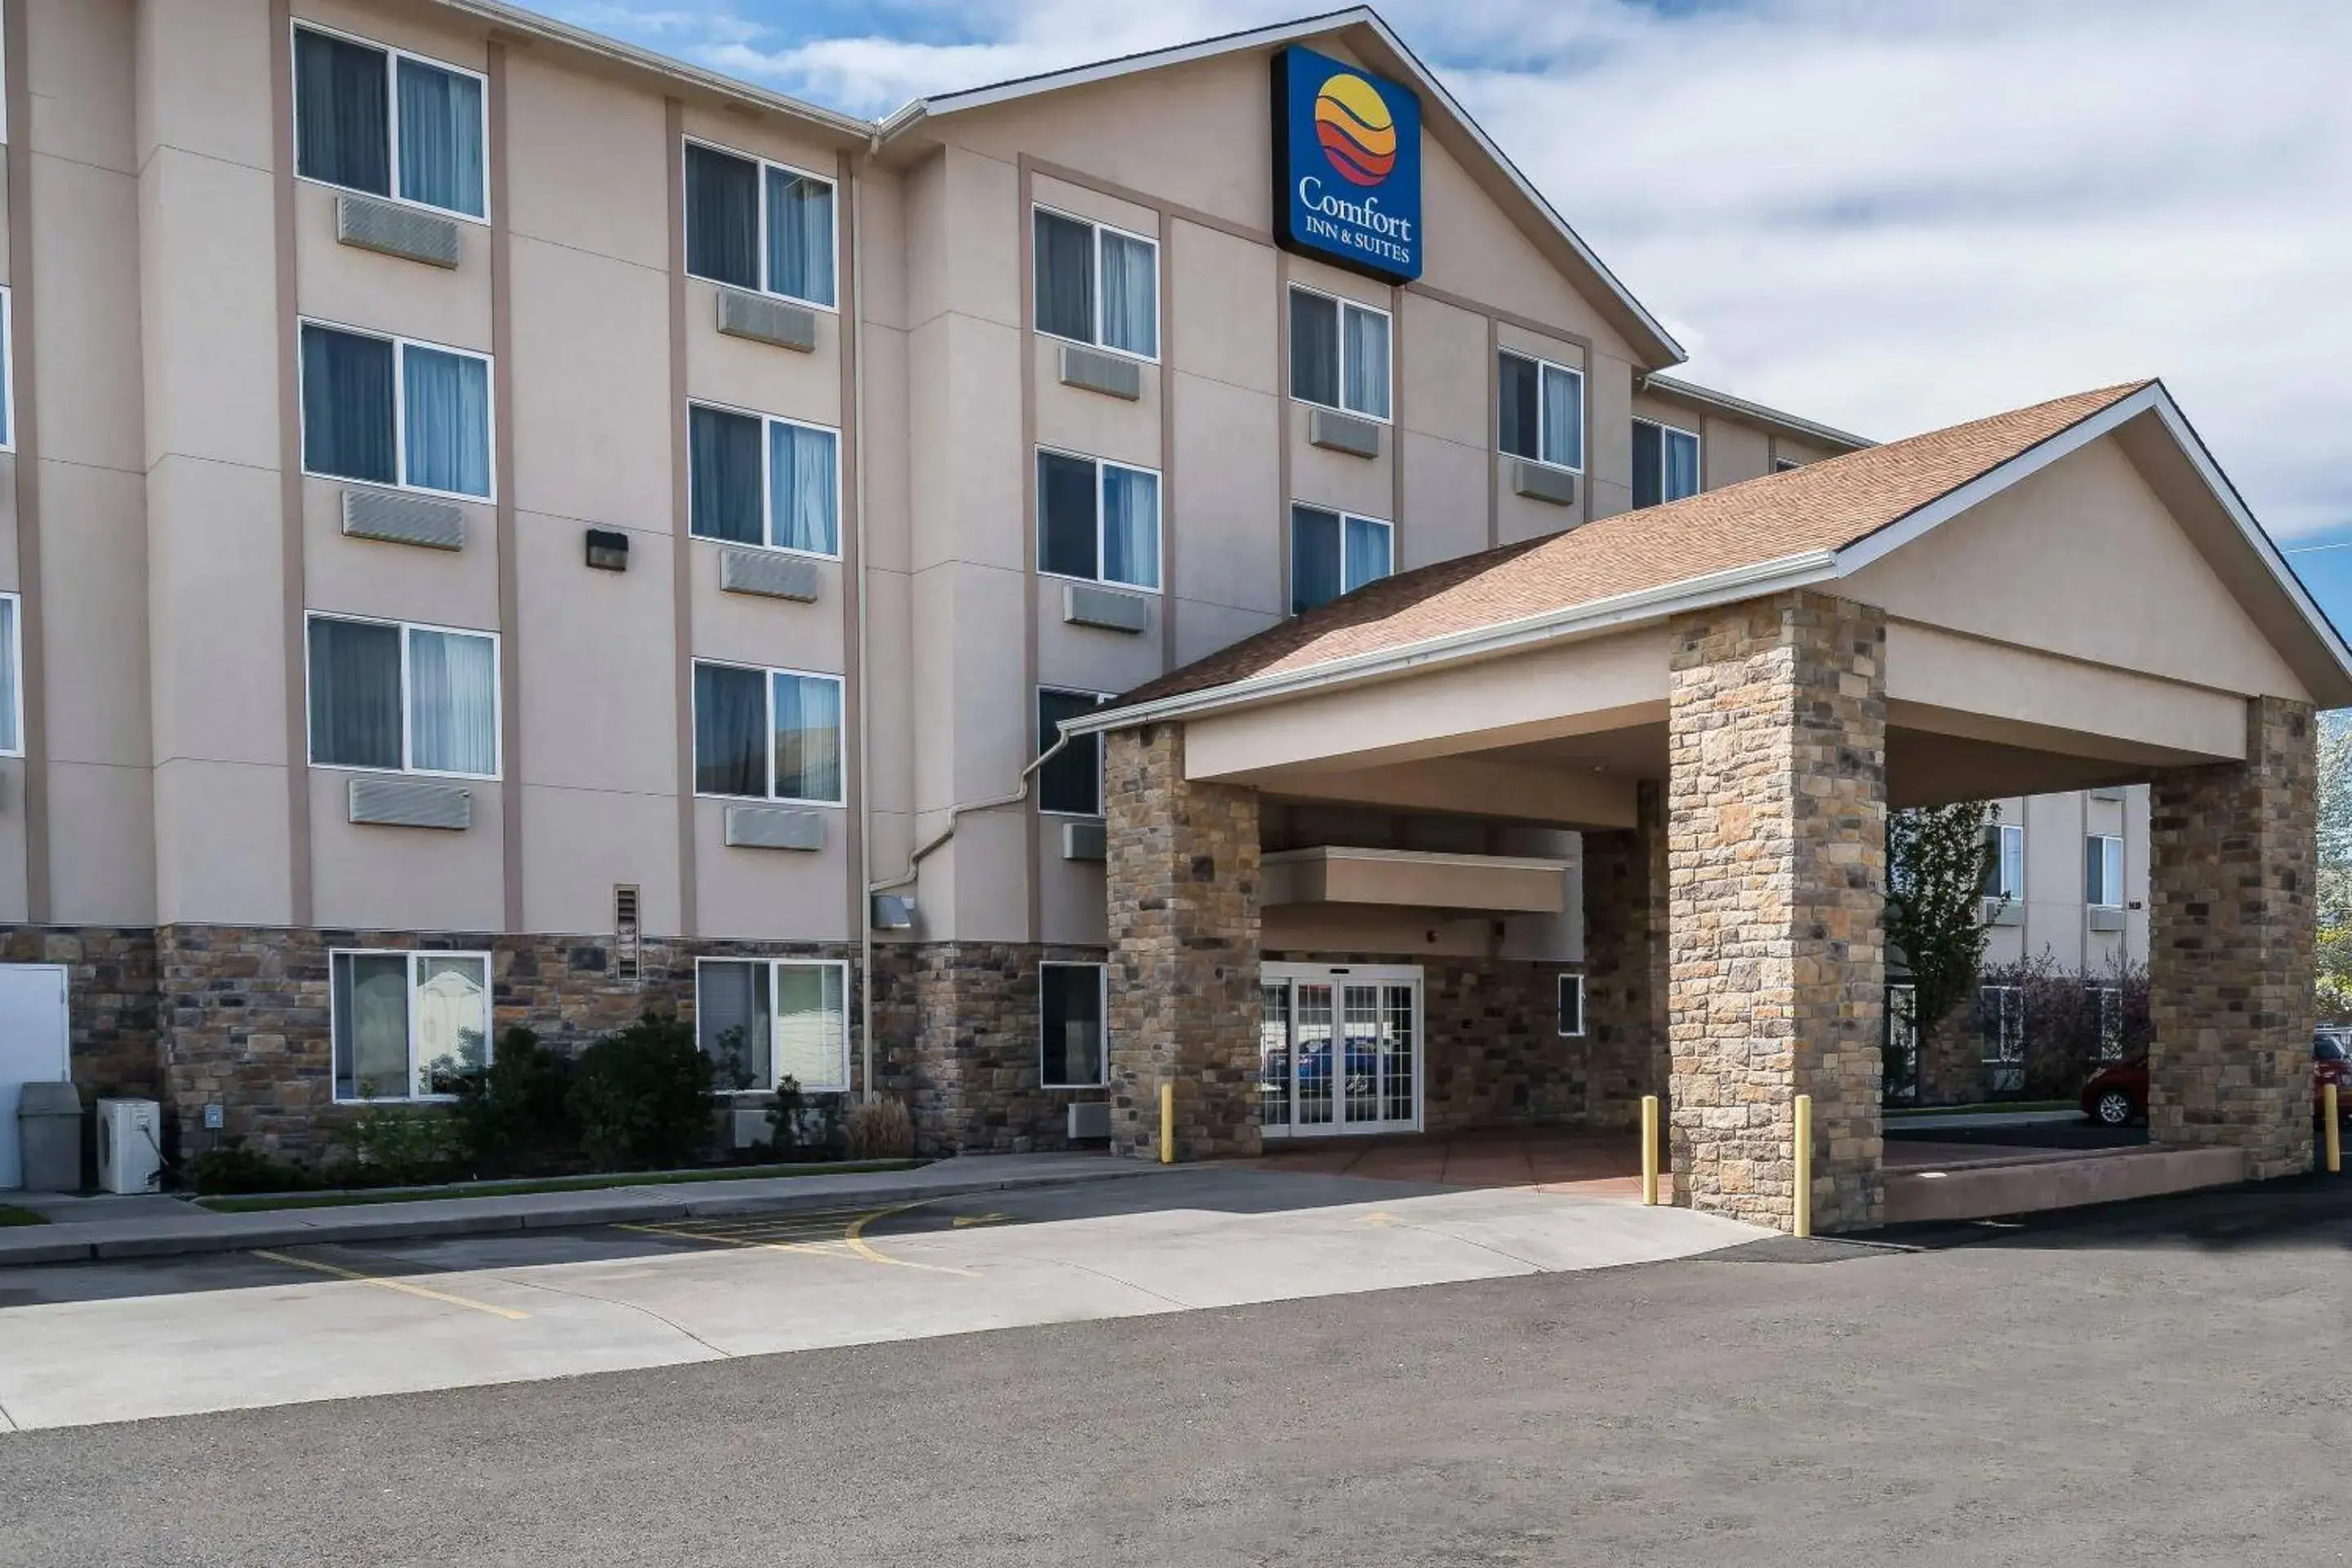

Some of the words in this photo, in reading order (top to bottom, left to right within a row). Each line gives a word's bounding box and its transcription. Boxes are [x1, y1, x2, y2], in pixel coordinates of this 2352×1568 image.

[1299, 176, 1411, 242] Comfort
[1306, 216, 1338, 240] INN
[1341, 229, 1352, 244] &
[1355, 232, 1410, 263] SUITES
